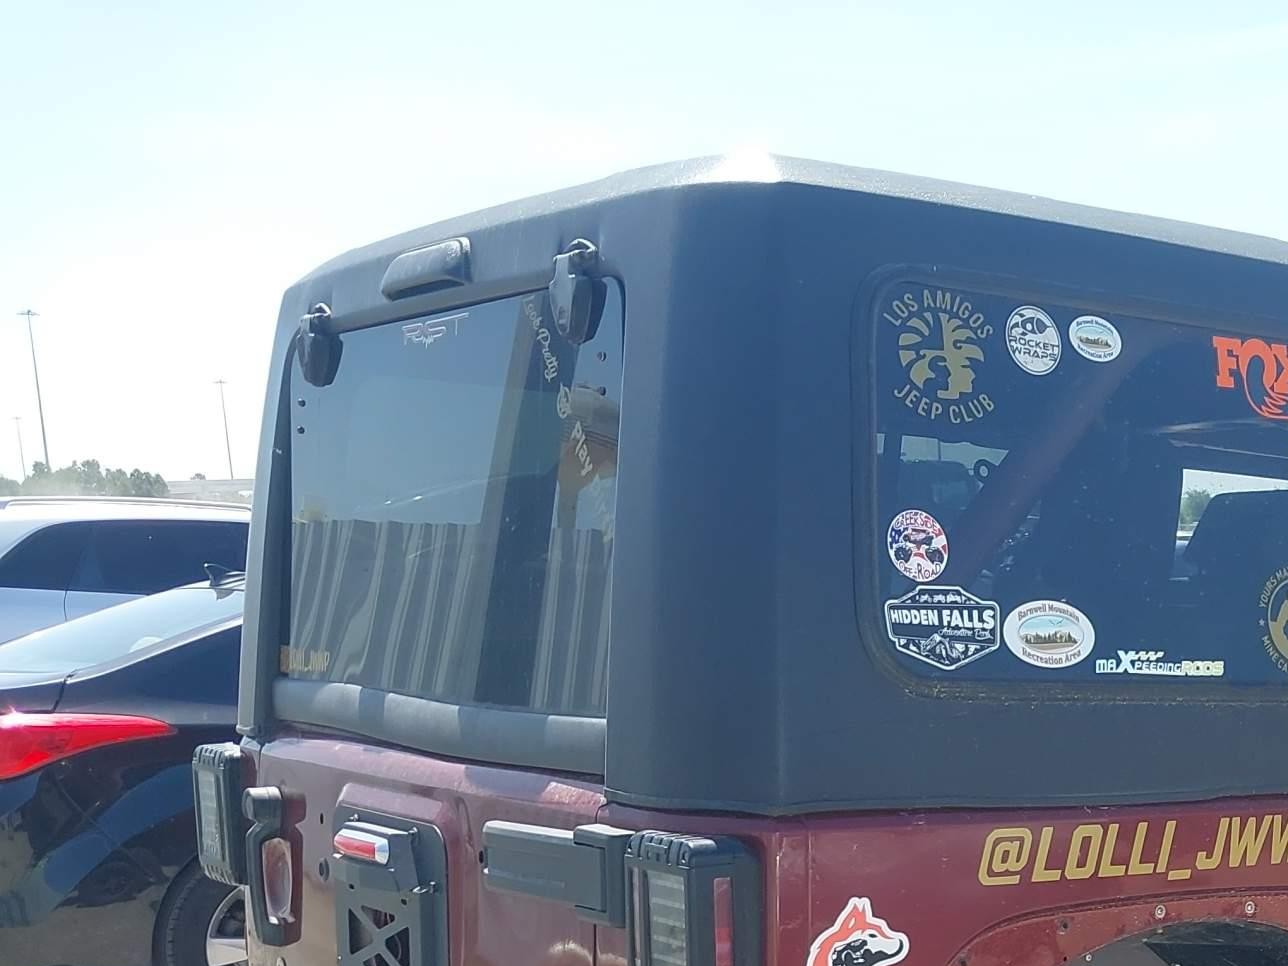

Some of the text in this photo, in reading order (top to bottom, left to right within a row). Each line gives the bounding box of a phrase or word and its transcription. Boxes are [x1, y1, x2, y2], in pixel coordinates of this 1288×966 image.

[883, 289, 993, 338] LOS AMIGOS
[1009, 335, 1059, 352] ROCKET
[1010, 345, 1057, 361] WRAPS
[536, 328, 558, 383] Pretty
[570, 421, 593, 477] Play
[894, 384, 995, 424] JEEP CLUB
[1259, 576, 1278, 608] YOURS
[890, 608, 995, 630] HIDDEN FALLS
[1018, 602, 1080, 622] Barnwell Mountain
[1021, 647, 1082, 665] Recreation Area
[1262, 635, 1279, 662] MINE
